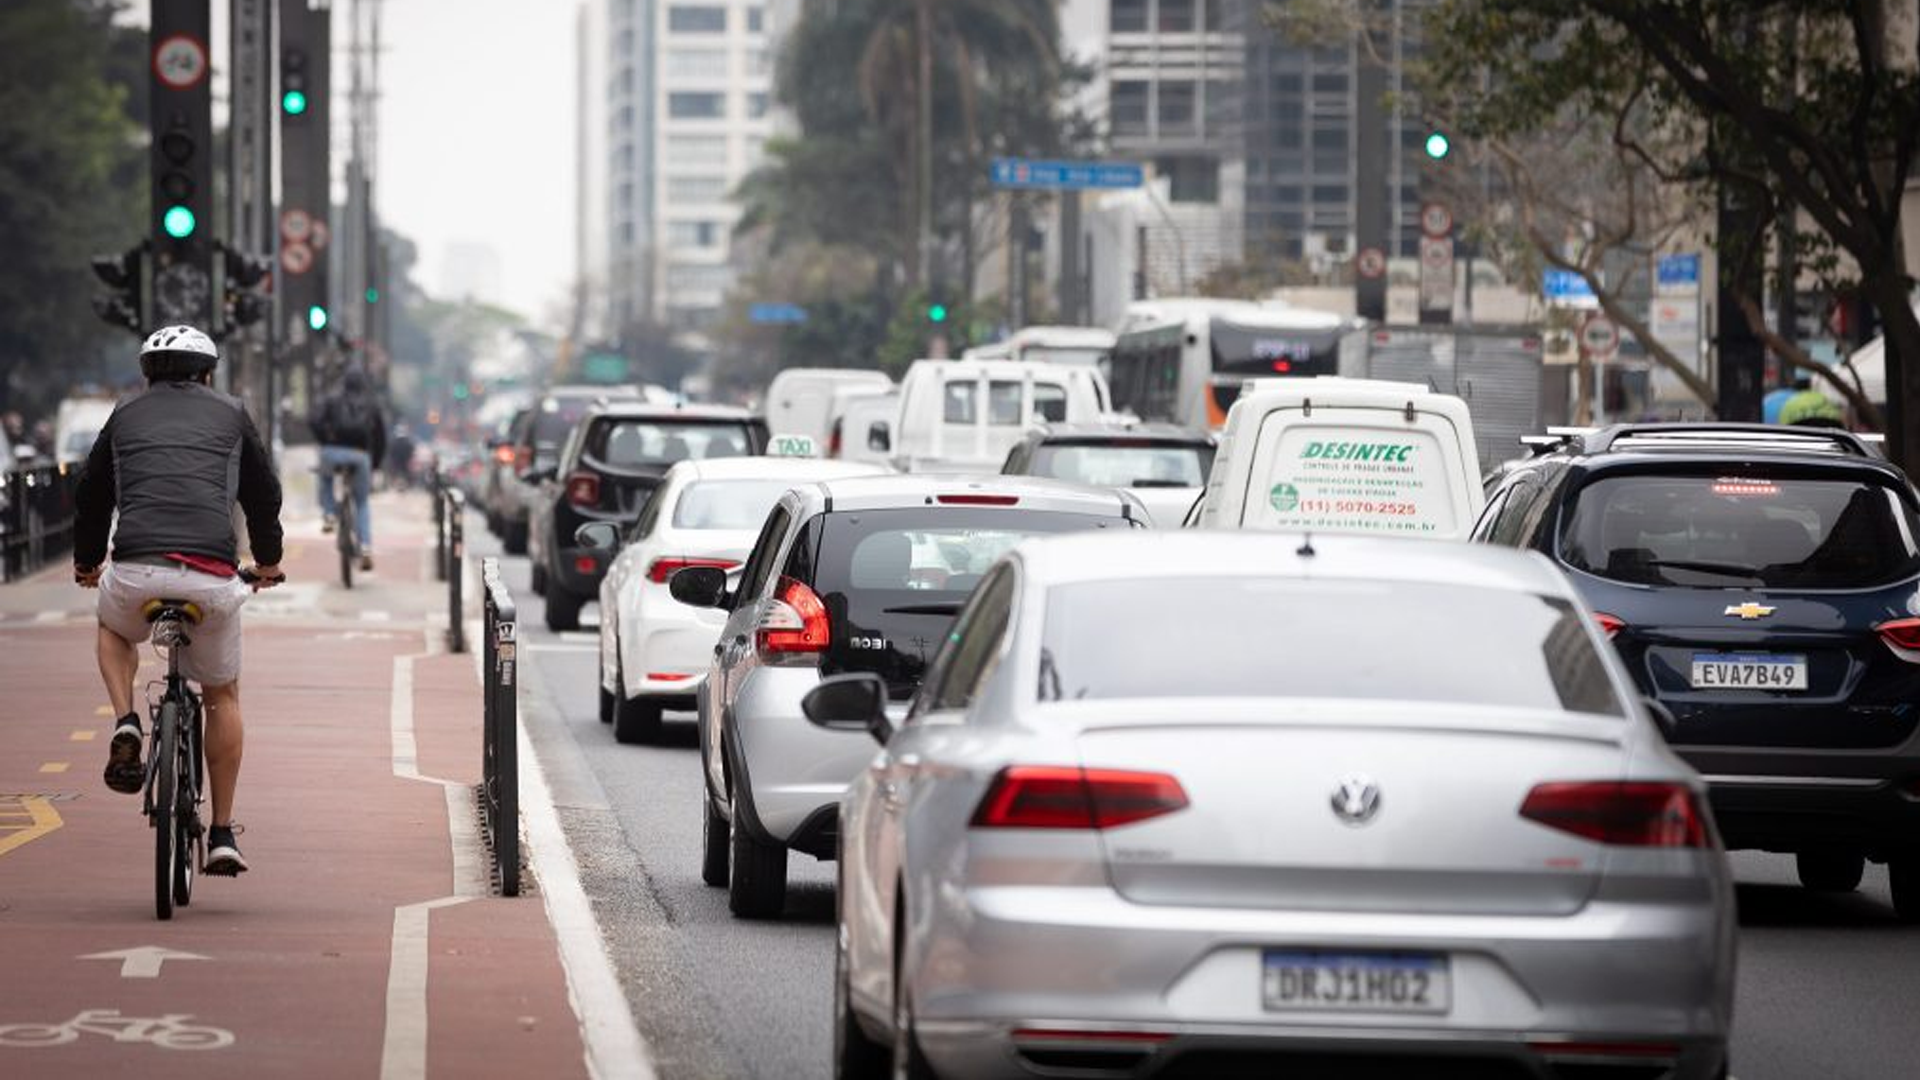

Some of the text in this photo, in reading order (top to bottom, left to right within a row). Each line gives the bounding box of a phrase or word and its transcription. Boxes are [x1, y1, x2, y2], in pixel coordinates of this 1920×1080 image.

[775, 437, 811, 455] TAXI
[1301, 441, 1413, 462] DESINTEC
[1300, 500, 1331, 515] (11)
[1335, 500, 1416, 516] 5070-2525
[1278, 516, 1436, 532] www.desintec.com.br
[1703, 664, 1795, 685] EVA7B49
[1280, 966, 1430, 1003] DRJ1H02
